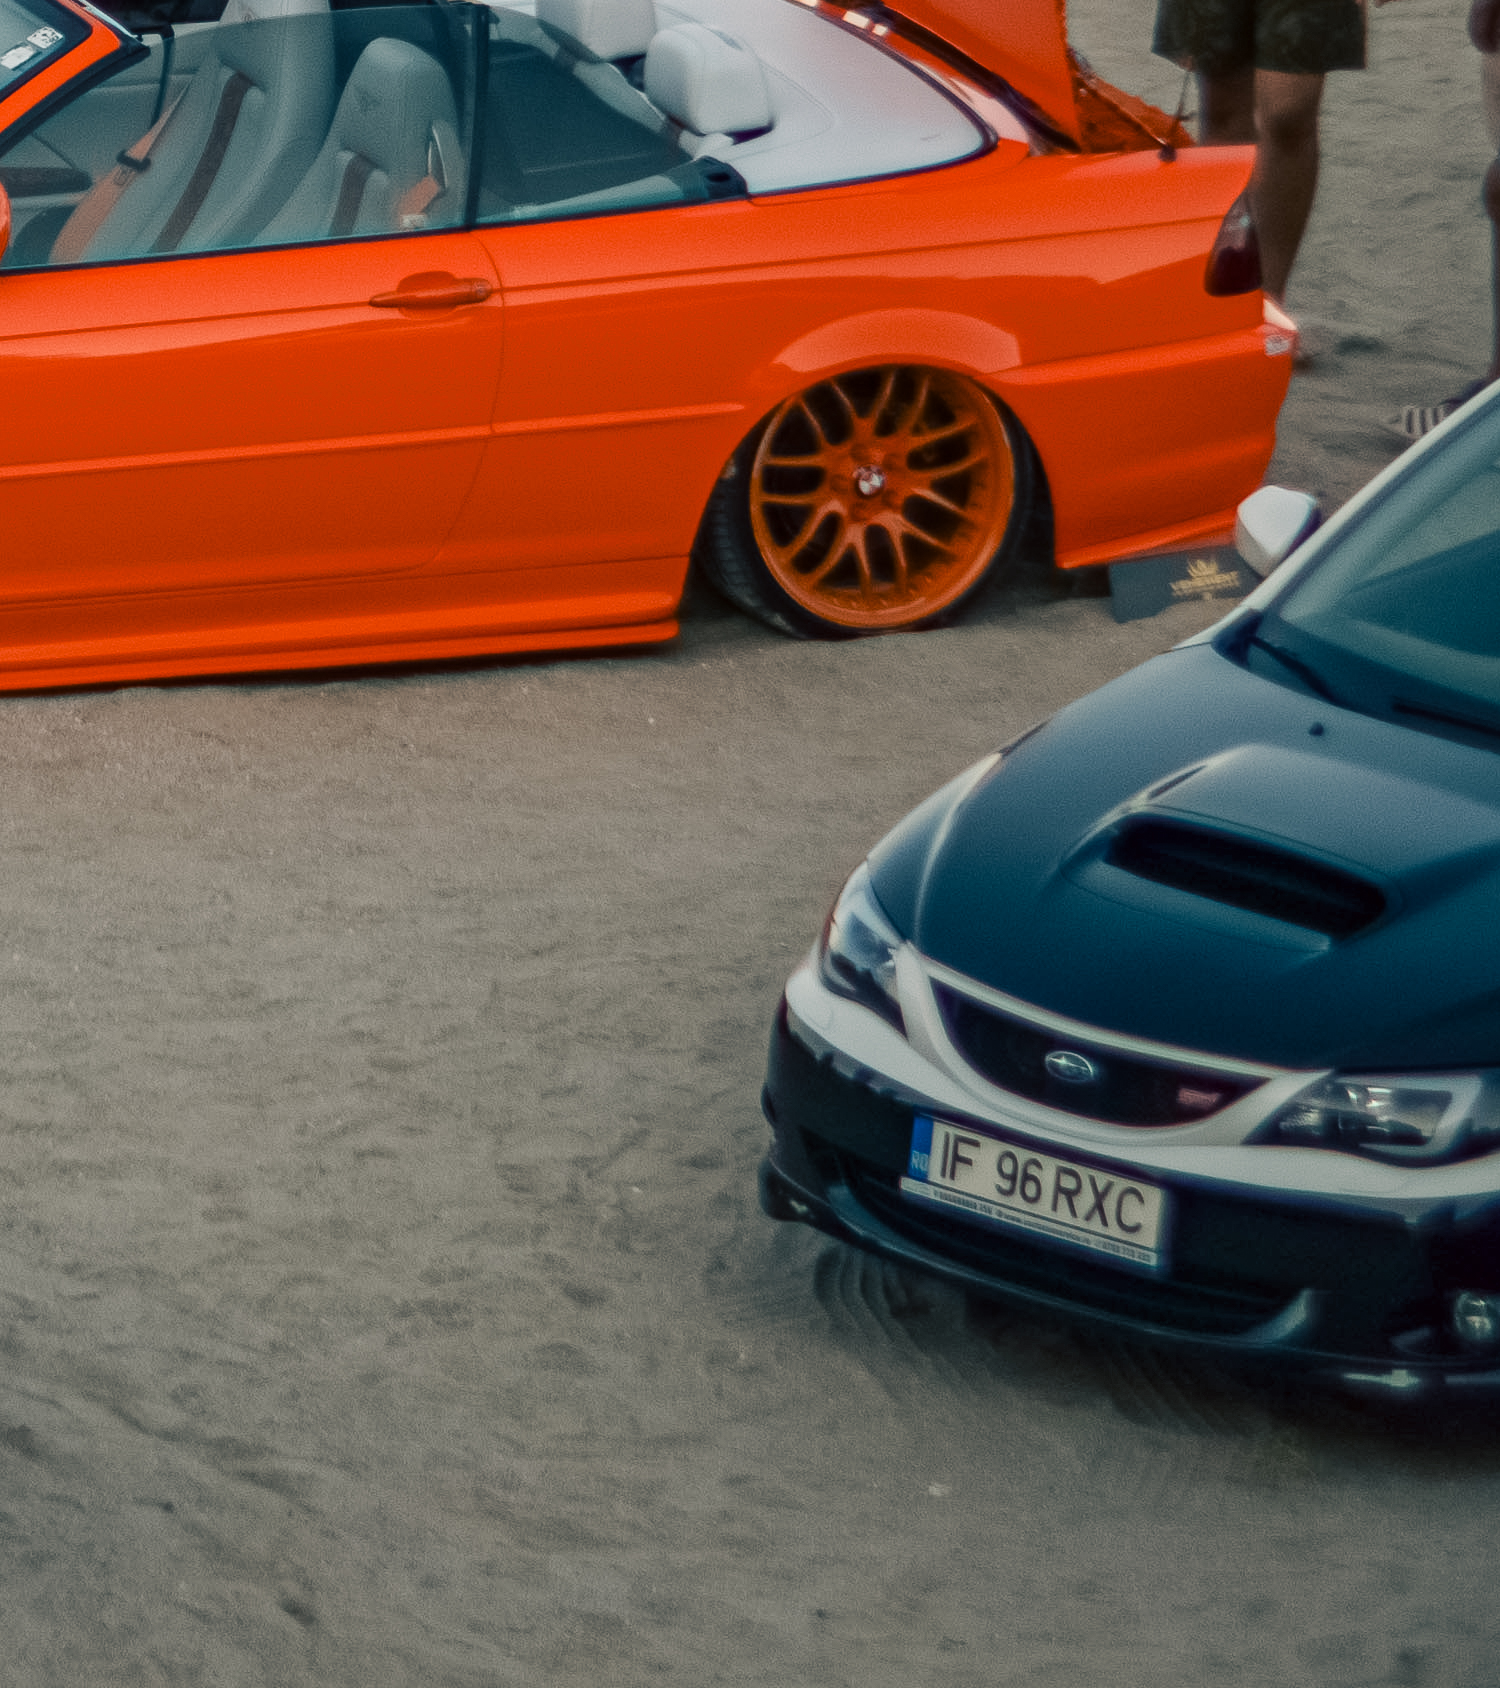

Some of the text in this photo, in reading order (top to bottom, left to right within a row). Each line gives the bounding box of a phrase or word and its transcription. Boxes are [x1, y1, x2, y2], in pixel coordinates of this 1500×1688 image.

[939, 1131, 981, 1181] IF
[994, 1149, 1043, 1204] 96
[1050, 1164, 1145, 1235] RXC
